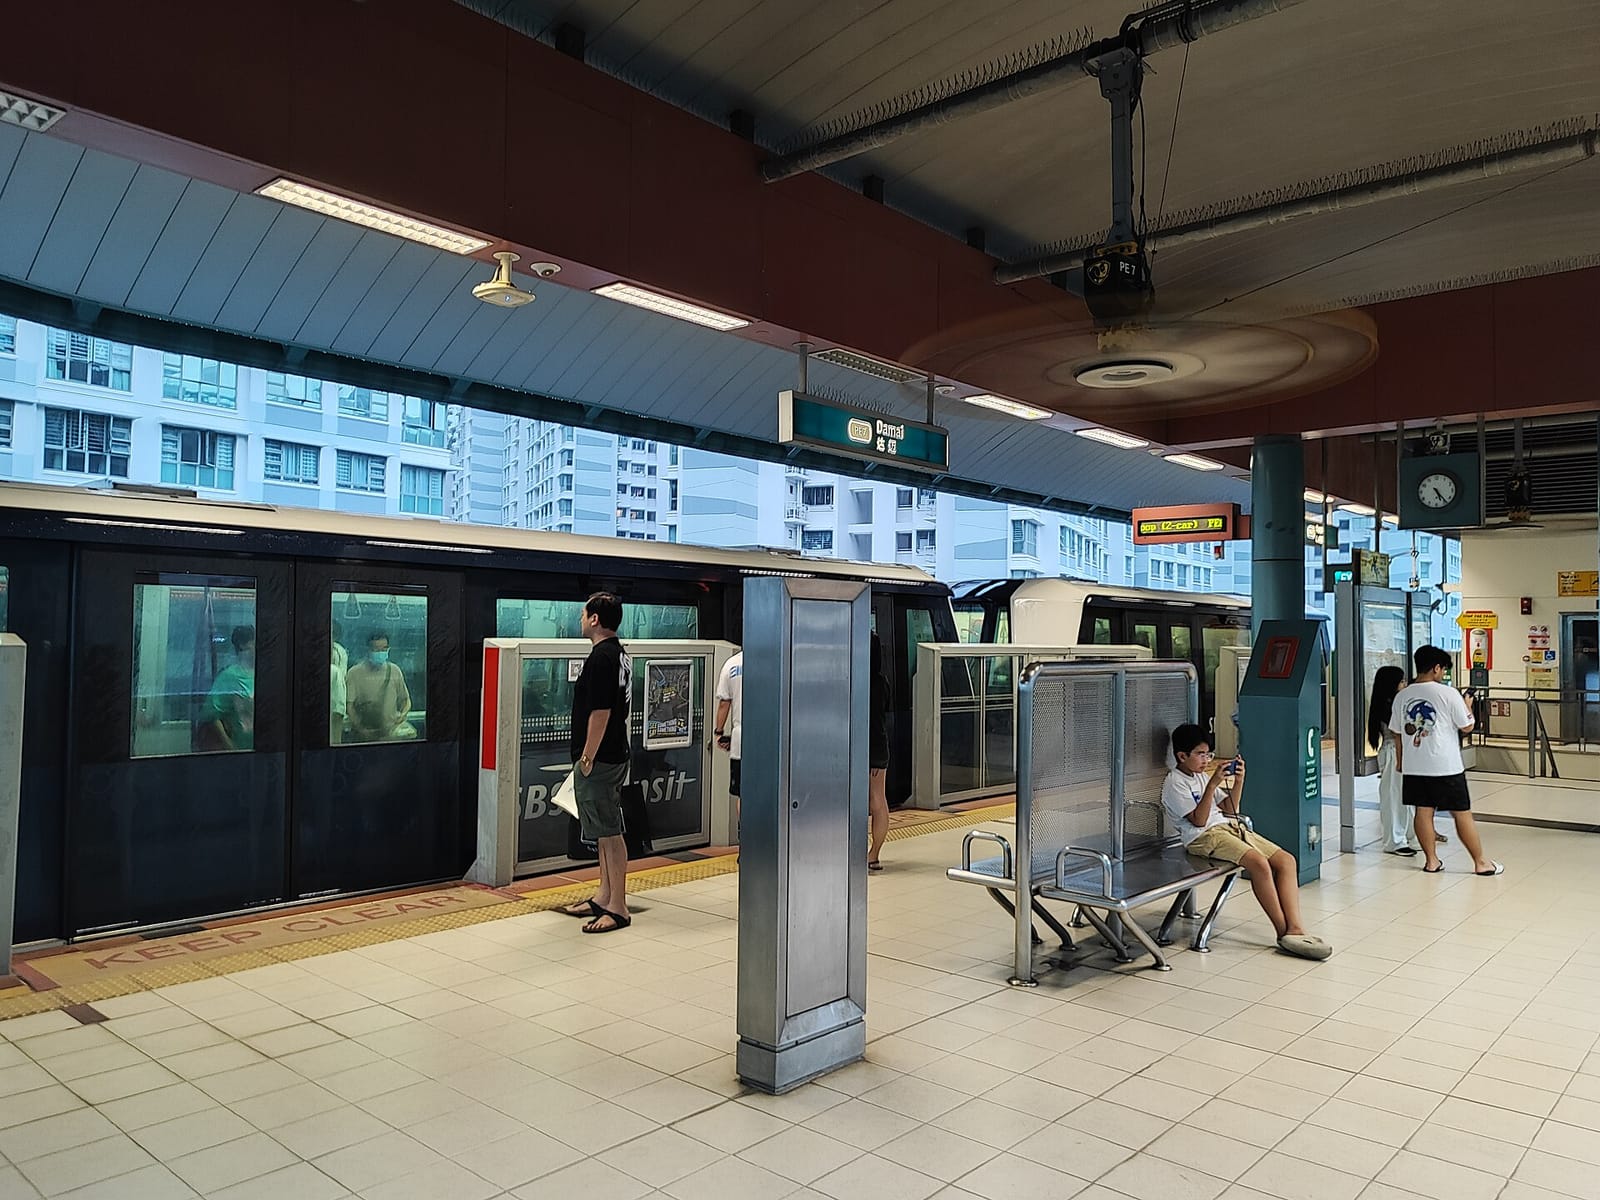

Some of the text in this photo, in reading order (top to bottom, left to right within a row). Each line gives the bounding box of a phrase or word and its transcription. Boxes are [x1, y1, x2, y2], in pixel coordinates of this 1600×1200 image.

[1120, 261, 1136, 275] PE7
[877, 420, 904, 440] Damai
[1161, 519, 1198, 531] (2-car)
[84, 894, 467, 970] KEEP CLEAR
